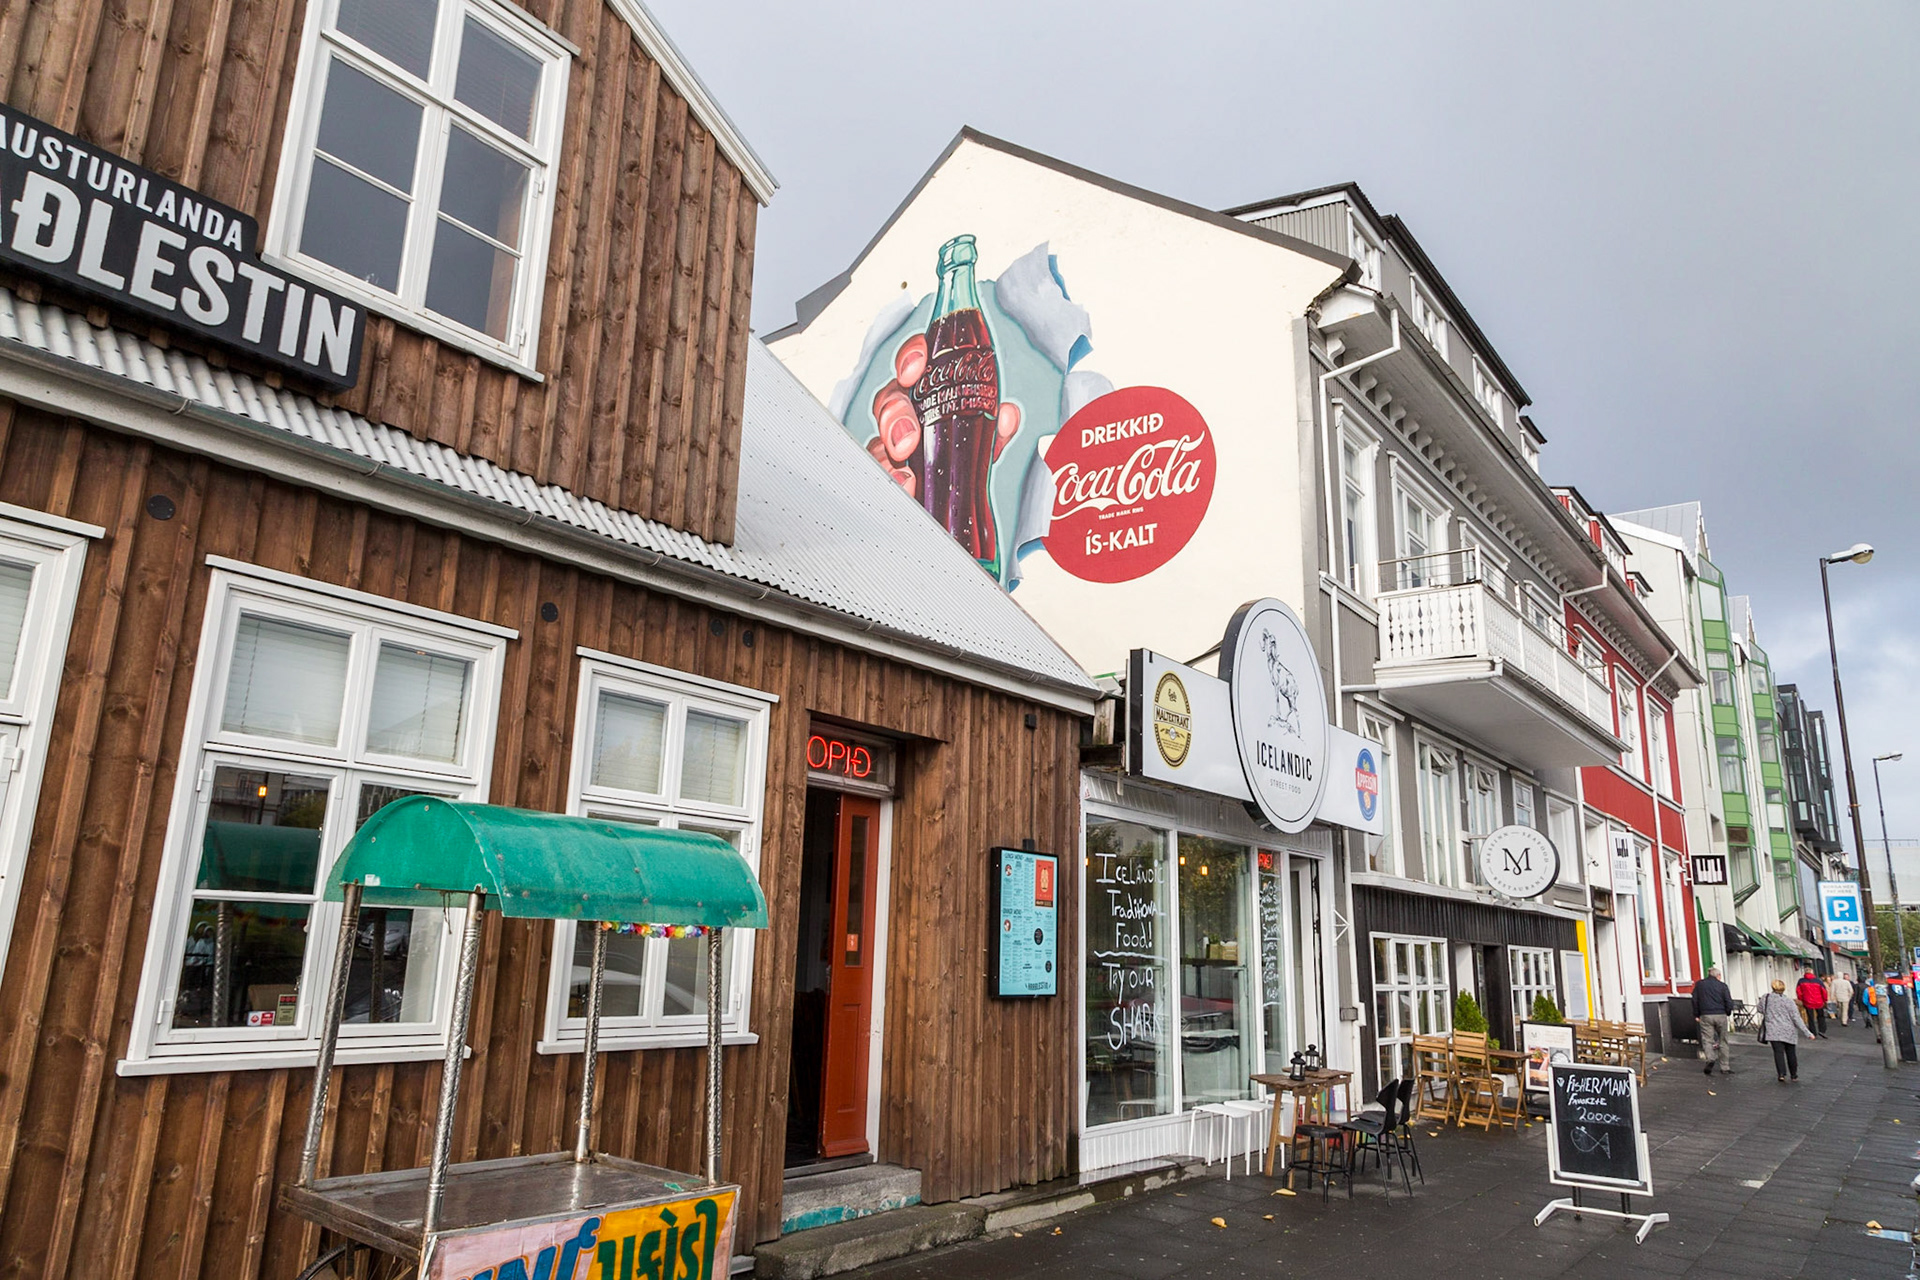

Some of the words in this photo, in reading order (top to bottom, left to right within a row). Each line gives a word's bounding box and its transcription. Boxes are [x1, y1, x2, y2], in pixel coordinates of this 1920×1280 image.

[0, 171, 356, 376] ÐLESTIN
[1081, 413, 1164, 448] DREKKIÐ
[1047, 431, 1205, 519] Coca-Cola
[1085, 523, 1158, 556] ÍS-KALT
[1156, 707, 1190, 729] MALTEXTRAKT
[807, 735, 871, 777] OPIÐ
[1256, 740, 1313, 781] ICELANDIC
[1270, 778, 1287, 790] STREET
[1288, 784, 1301, 795] FOOD
[1502, 847, 1533, 876] M
[1522, 832, 1549, 863] SEAFOOD
[1493, 876, 1545, 891] RESTAURANT
[1833, 900, 1849, 917] P
[1129, 968, 1154, 989] OUR
[1107, 1003, 1164, 1050] SHARK
